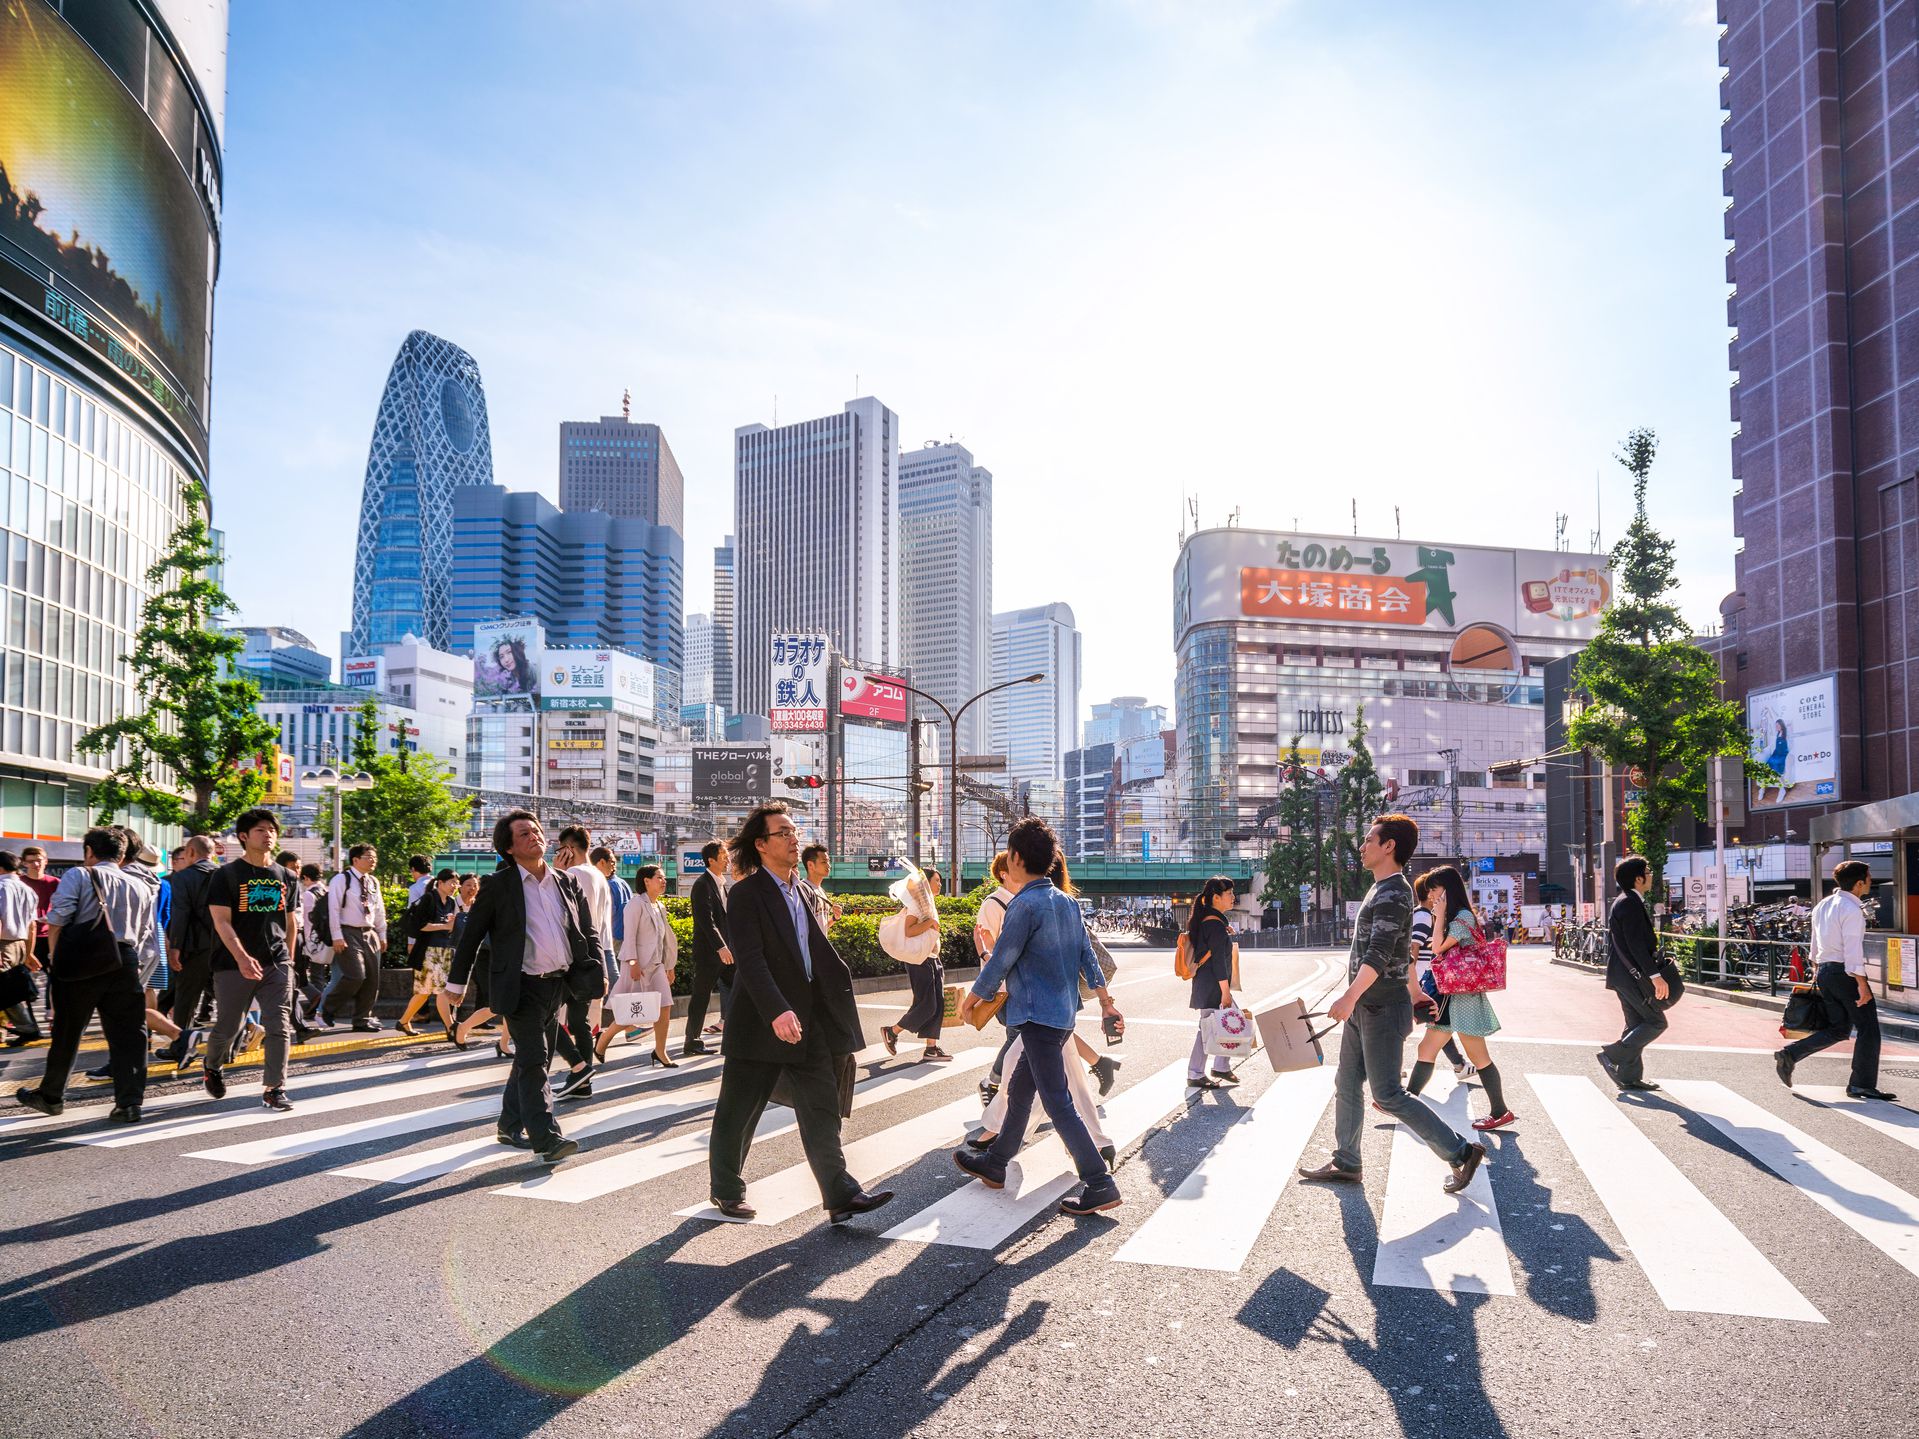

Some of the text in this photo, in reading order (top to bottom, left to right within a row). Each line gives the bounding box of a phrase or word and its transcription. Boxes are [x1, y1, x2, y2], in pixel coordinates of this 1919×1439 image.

[1277, 540, 1391, 574] たのめーる
[1257, 580, 1411, 613] 大塚商会
[772, 635, 826, 666] カラオケ
[571, 665, 605, 674] シェーン
[793, 663, 805, 681] の
[571, 674, 604, 684] 英会話
[776, 679, 821, 707] 鉄人
[873, 685, 904, 701] アコム
[1799, 694, 1825, 705] coen
[550, 699, 586, 708] 新宿本校
[869, 707, 880, 716] 2F
[1799, 703, 1826, 713] GENERAL
[1298, 702, 1344, 743] TIPNESS
[1797, 751, 1832, 763] Can Do
[710, 771, 744, 787] global
